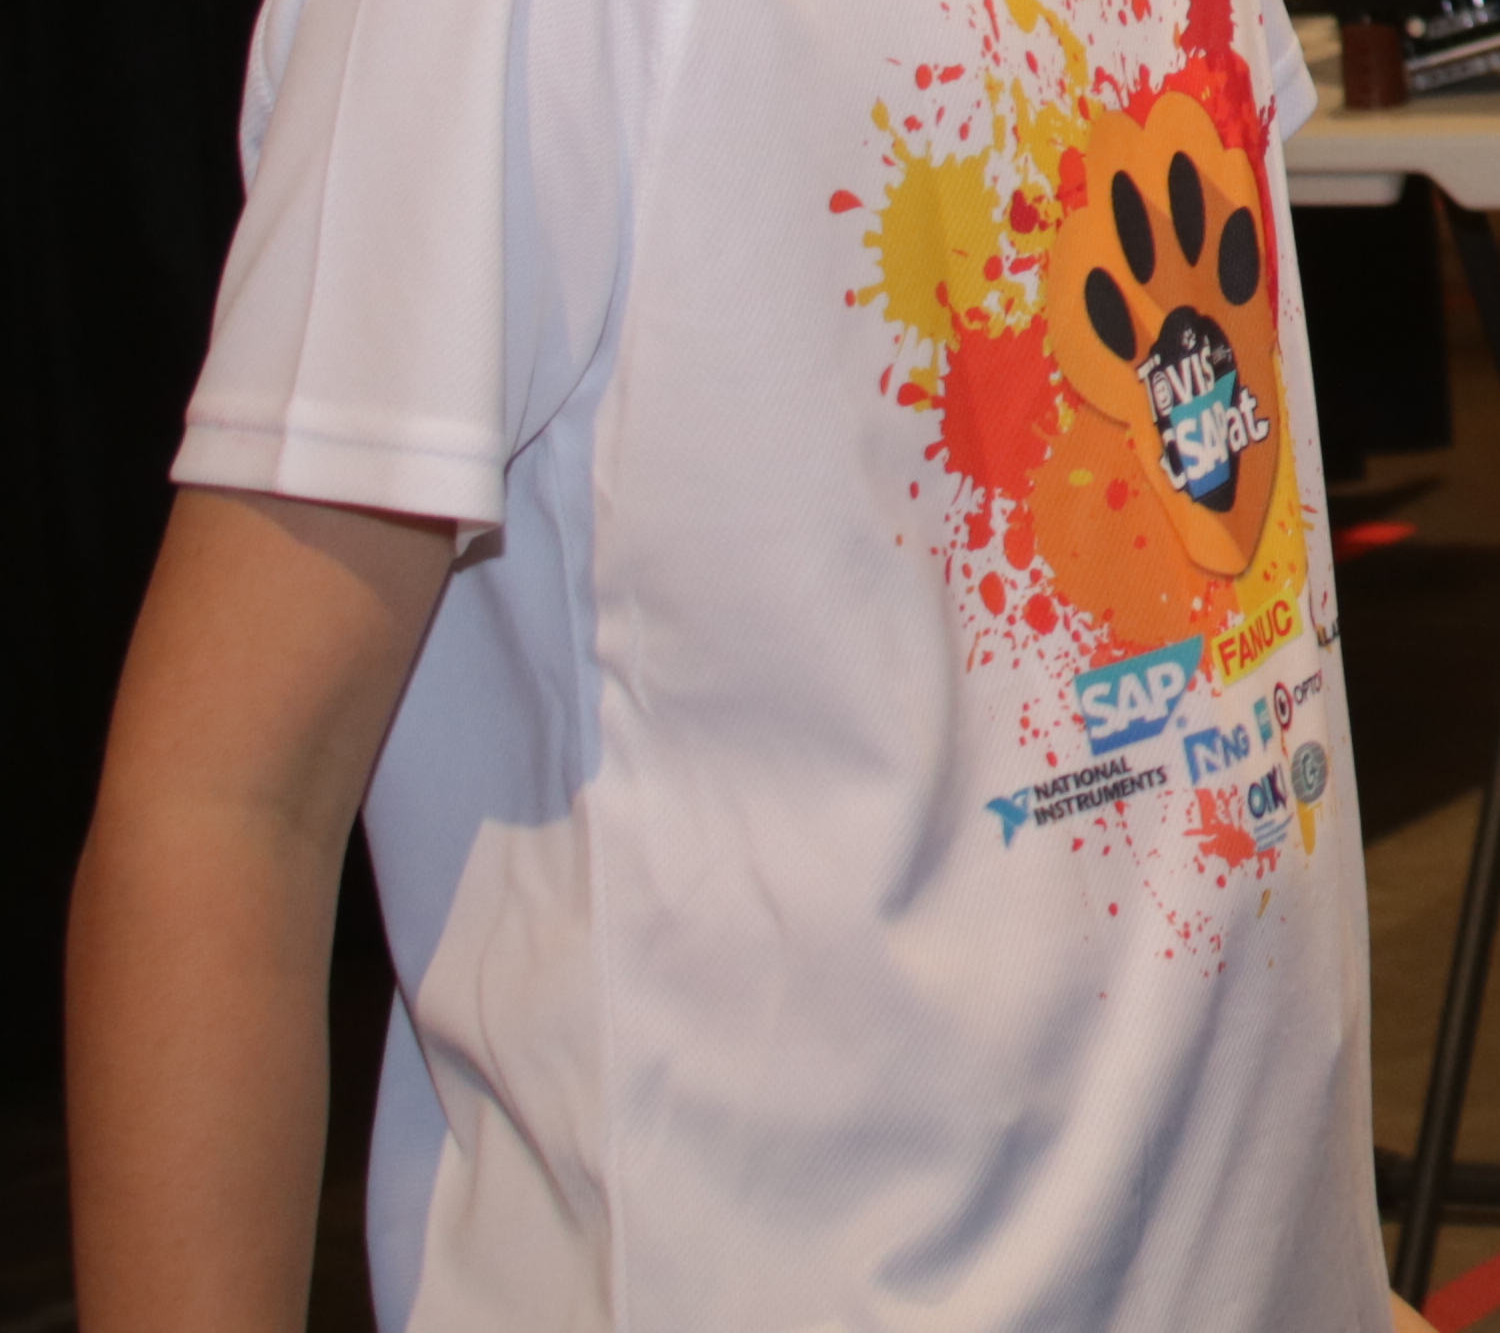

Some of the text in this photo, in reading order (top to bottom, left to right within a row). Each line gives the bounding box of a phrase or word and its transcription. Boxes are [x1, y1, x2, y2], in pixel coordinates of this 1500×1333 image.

[1218, 599, 1294, 677] FANUC
[1081, 661, 1187, 740] SAP
[1033, 755, 1133, 802] NATIONAL
[1033, 765, 1169, 826] INSTRUMENTS
